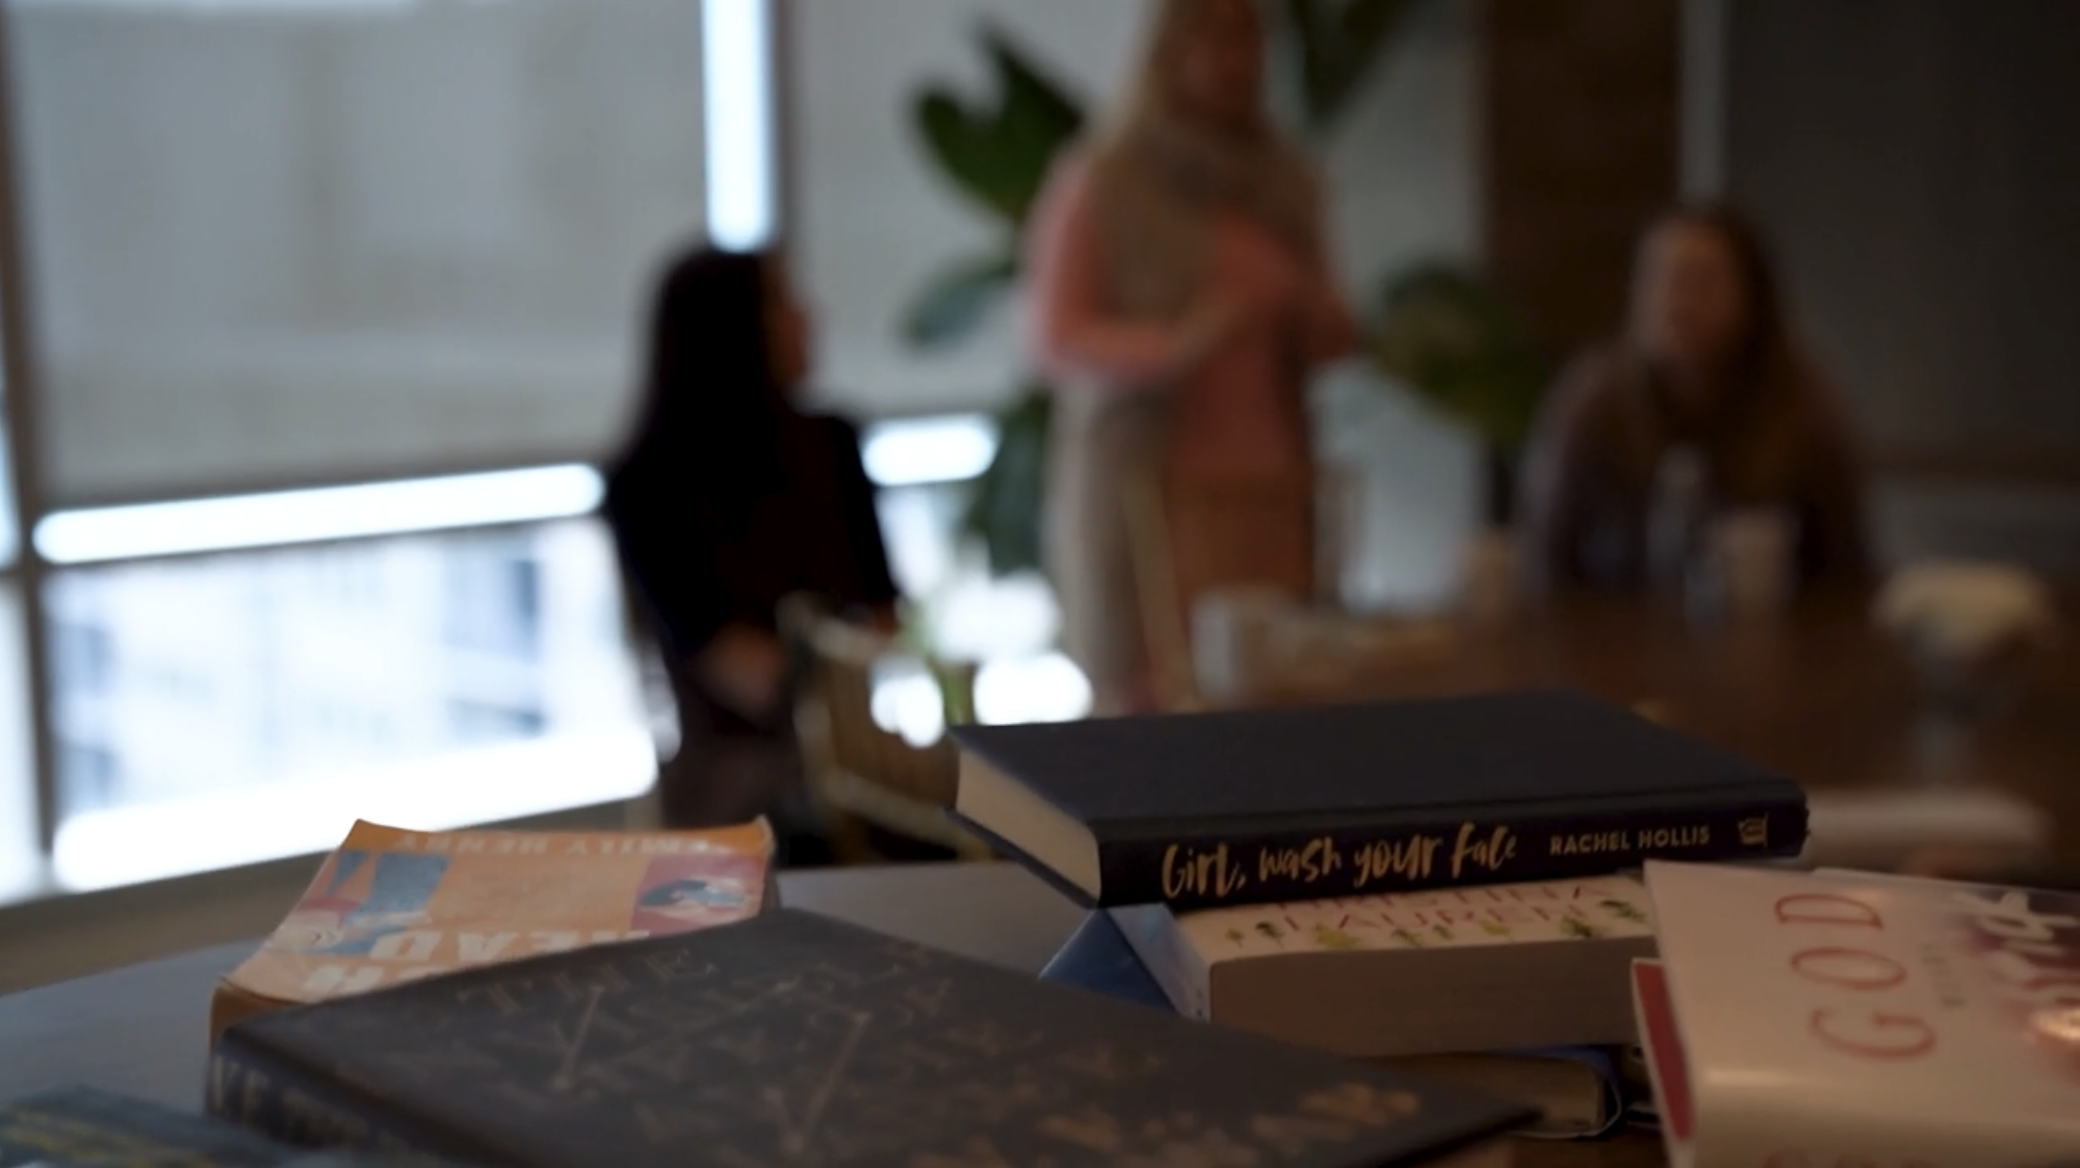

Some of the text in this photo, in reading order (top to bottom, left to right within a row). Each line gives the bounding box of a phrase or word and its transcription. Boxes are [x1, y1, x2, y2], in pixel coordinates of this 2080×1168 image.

[1257, 836, 1343, 884] wash
[1352, 833, 1443, 889] your
[1549, 821, 1711, 857] RACHEL HOLLIS
[1776, 894, 1937, 1059] GOD
